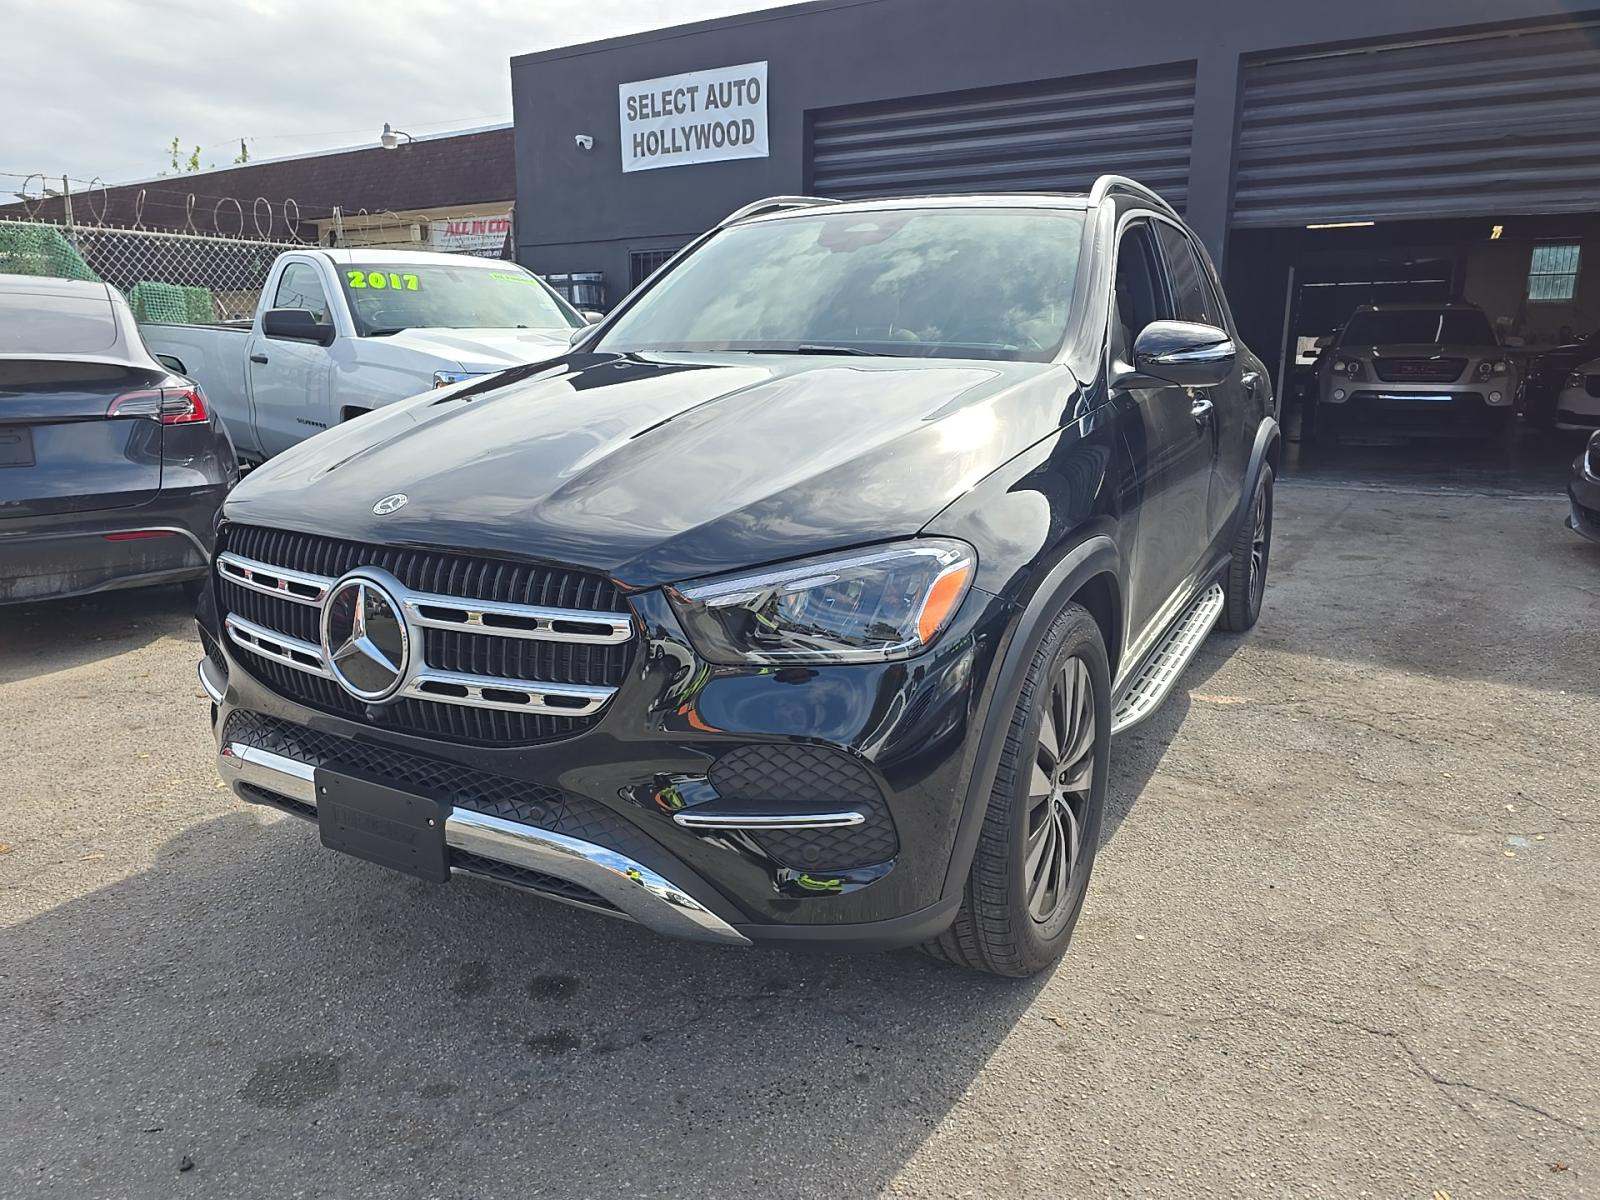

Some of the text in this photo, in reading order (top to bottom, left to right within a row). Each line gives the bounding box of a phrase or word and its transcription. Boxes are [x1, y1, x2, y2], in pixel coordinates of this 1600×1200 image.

[626, 77, 761, 122] SELECT AUTO
[633, 118, 755, 158] HOLLYWOOD
[444, 221, 469, 237] ALL
[347, 271, 418, 291] 2017
